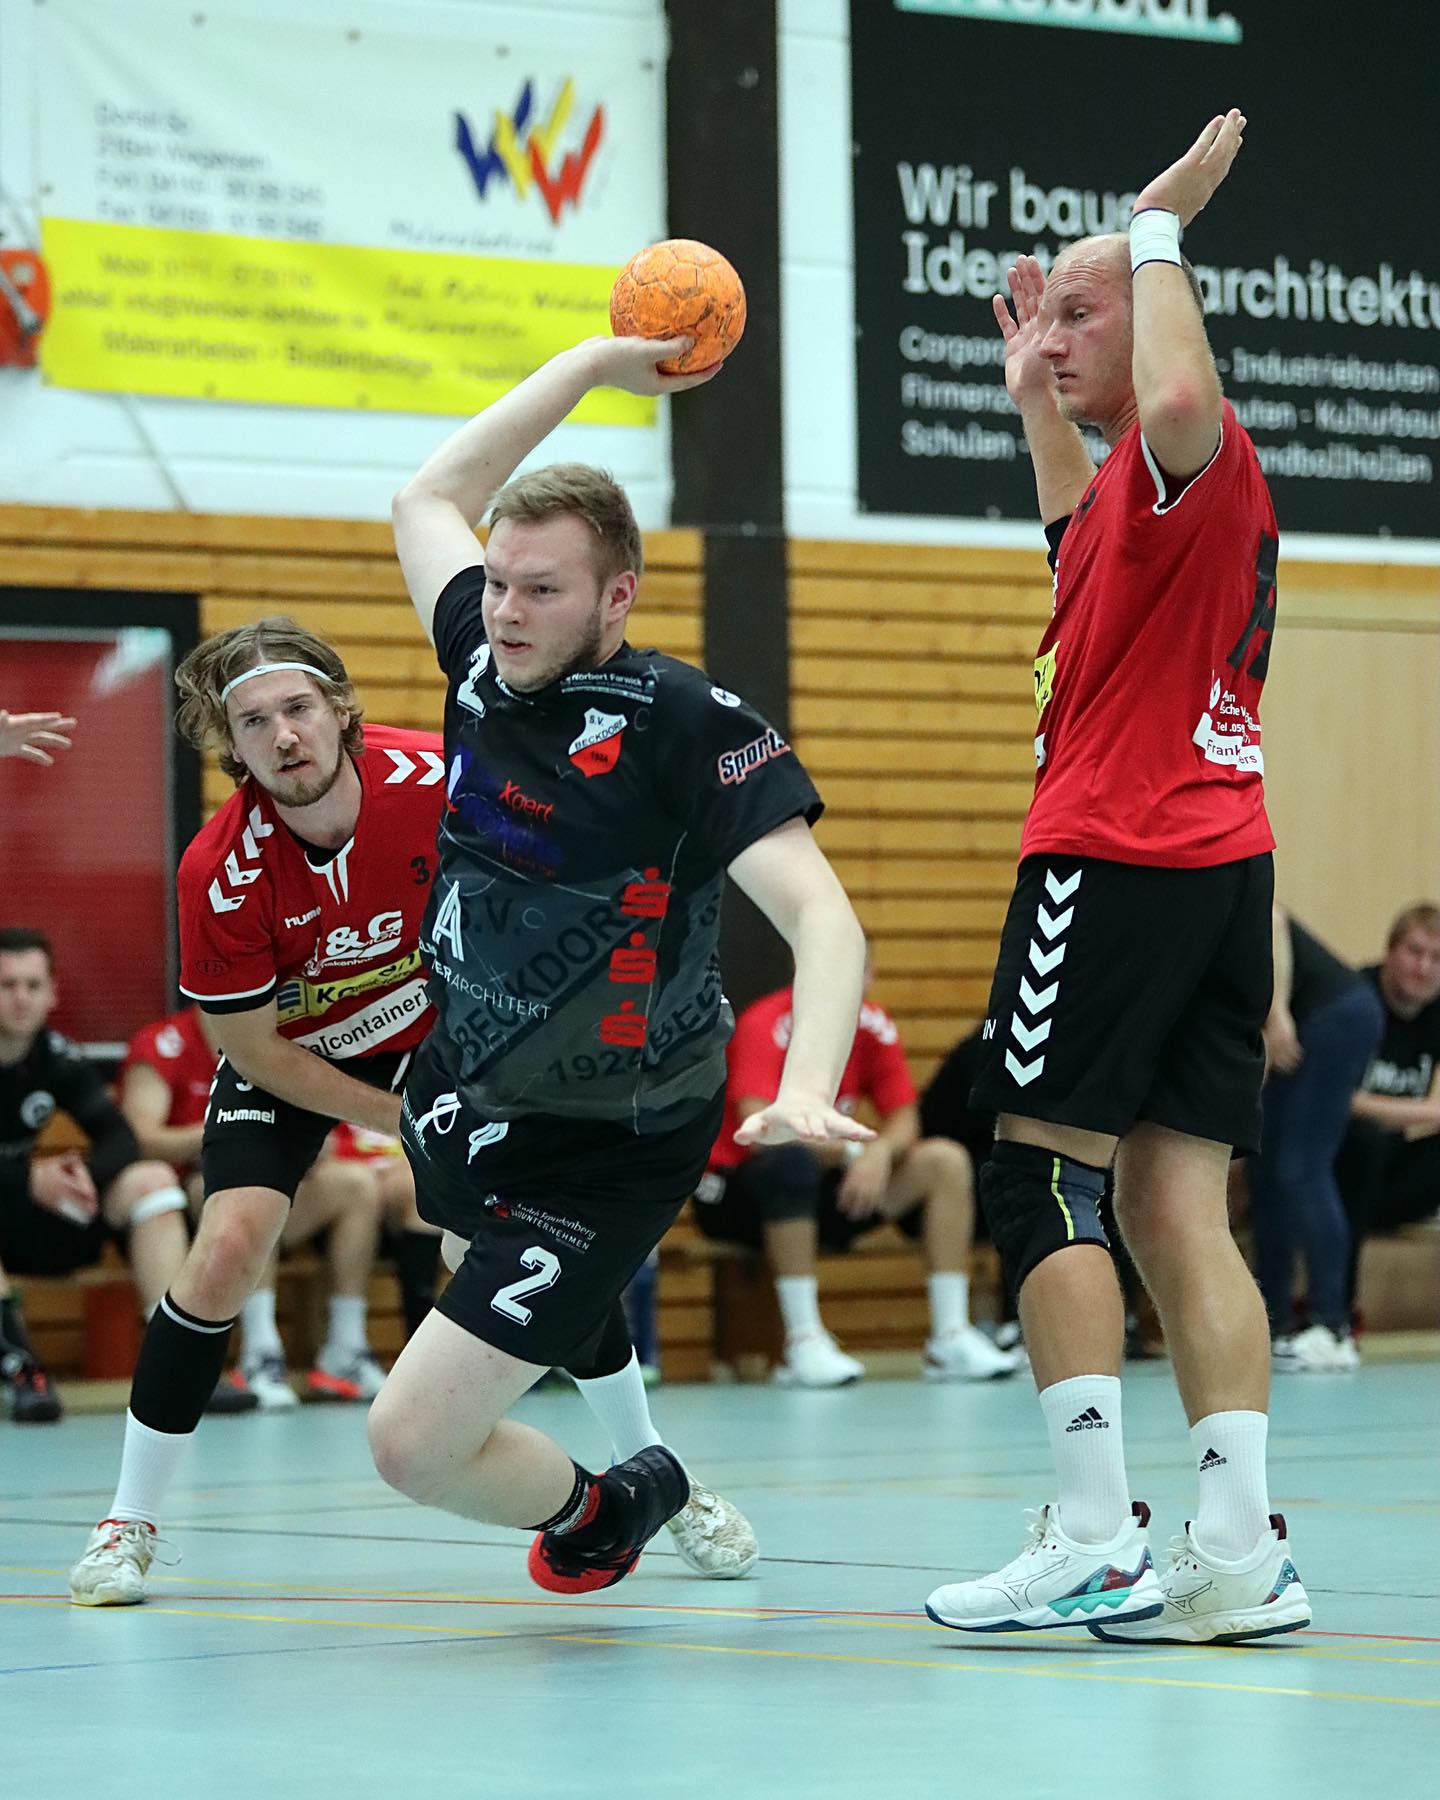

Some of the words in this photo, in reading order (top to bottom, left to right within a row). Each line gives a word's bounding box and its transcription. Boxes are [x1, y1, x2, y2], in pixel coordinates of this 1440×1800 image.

[897, 161, 998, 229] Wir
[902, 419, 1016, 462] Schulen
[456, 643, 490, 719] 2
[571, 672, 608, 682] Norbert
[574, 719, 625, 751] BECKDORF
[589, 714, 605, 727] S.V.
[410, 856, 431, 886] 3
[454, 888, 630, 1064] BECKDOR
[216, 1108, 275, 1125] hummel
[490, 1246, 563, 1328] 2
[1065, 1421, 1110, 1433] adidas
